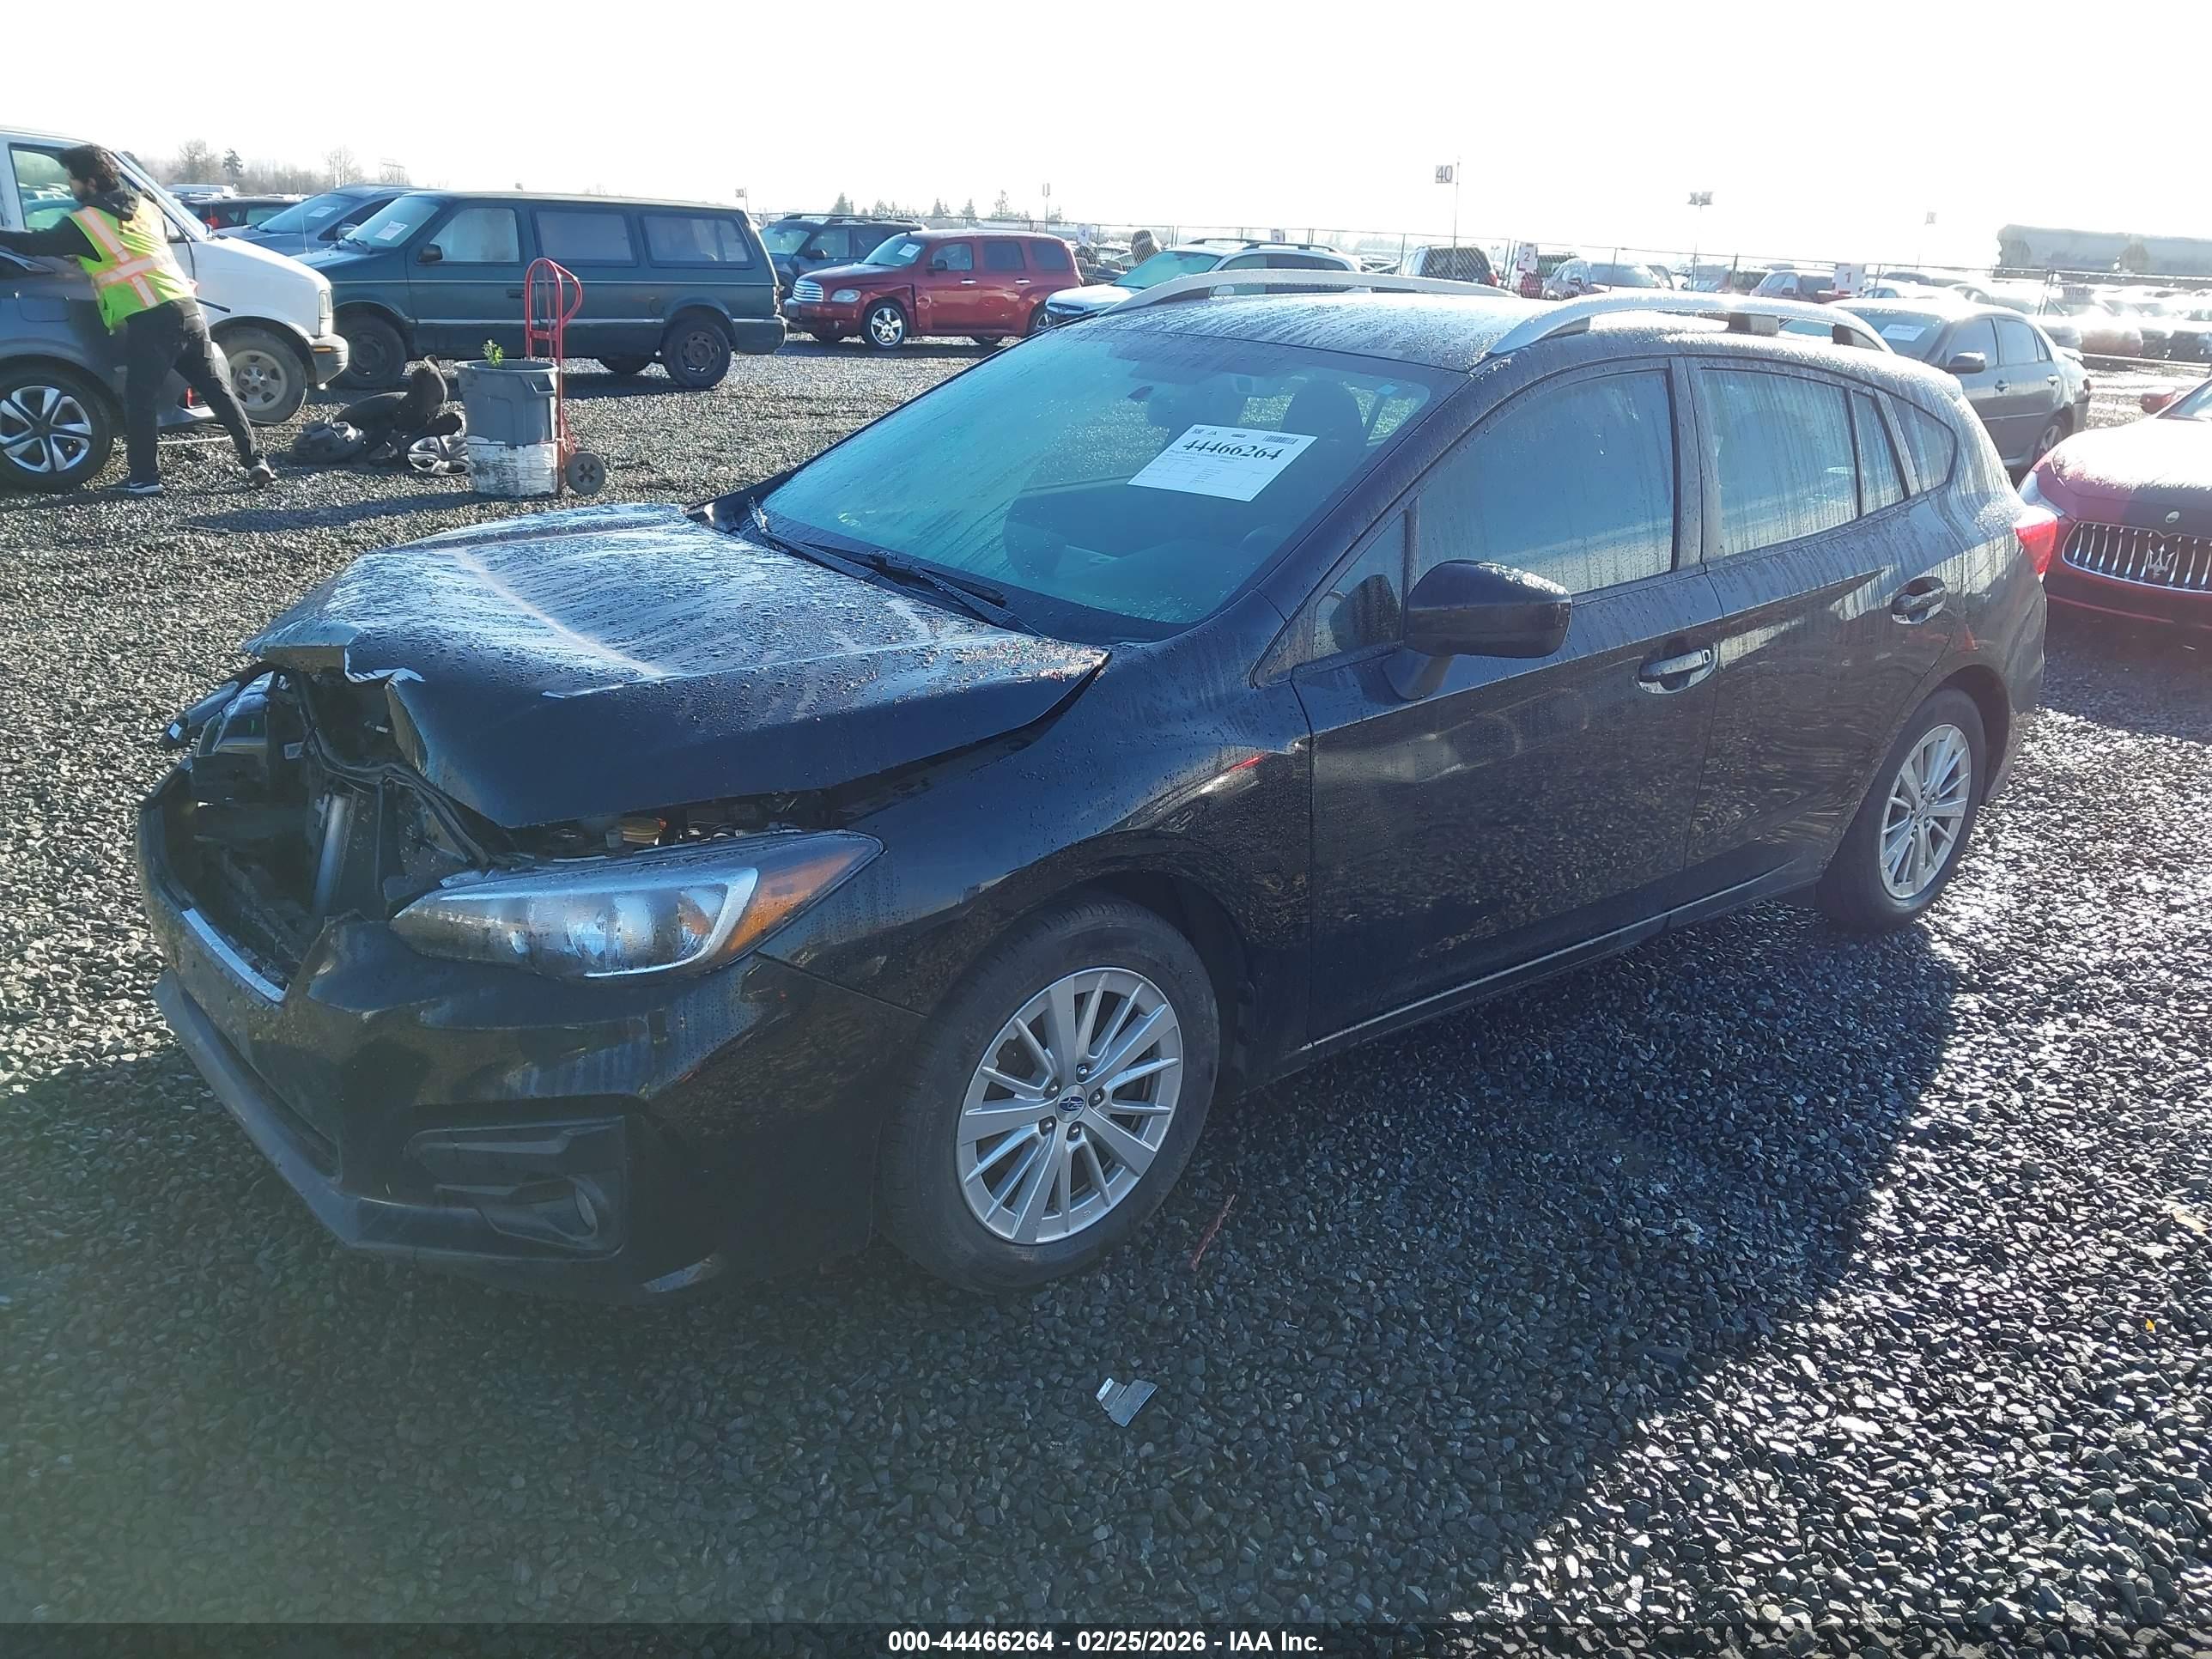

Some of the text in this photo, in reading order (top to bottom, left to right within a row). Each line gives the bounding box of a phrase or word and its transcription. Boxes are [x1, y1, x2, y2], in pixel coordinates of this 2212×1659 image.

[1436, 165, 1453, 182] 40
[1524, 252, 1530, 261] 2
[1845, 271, 1851, 283] 1
[1182, 440, 1285, 460] 44466264
